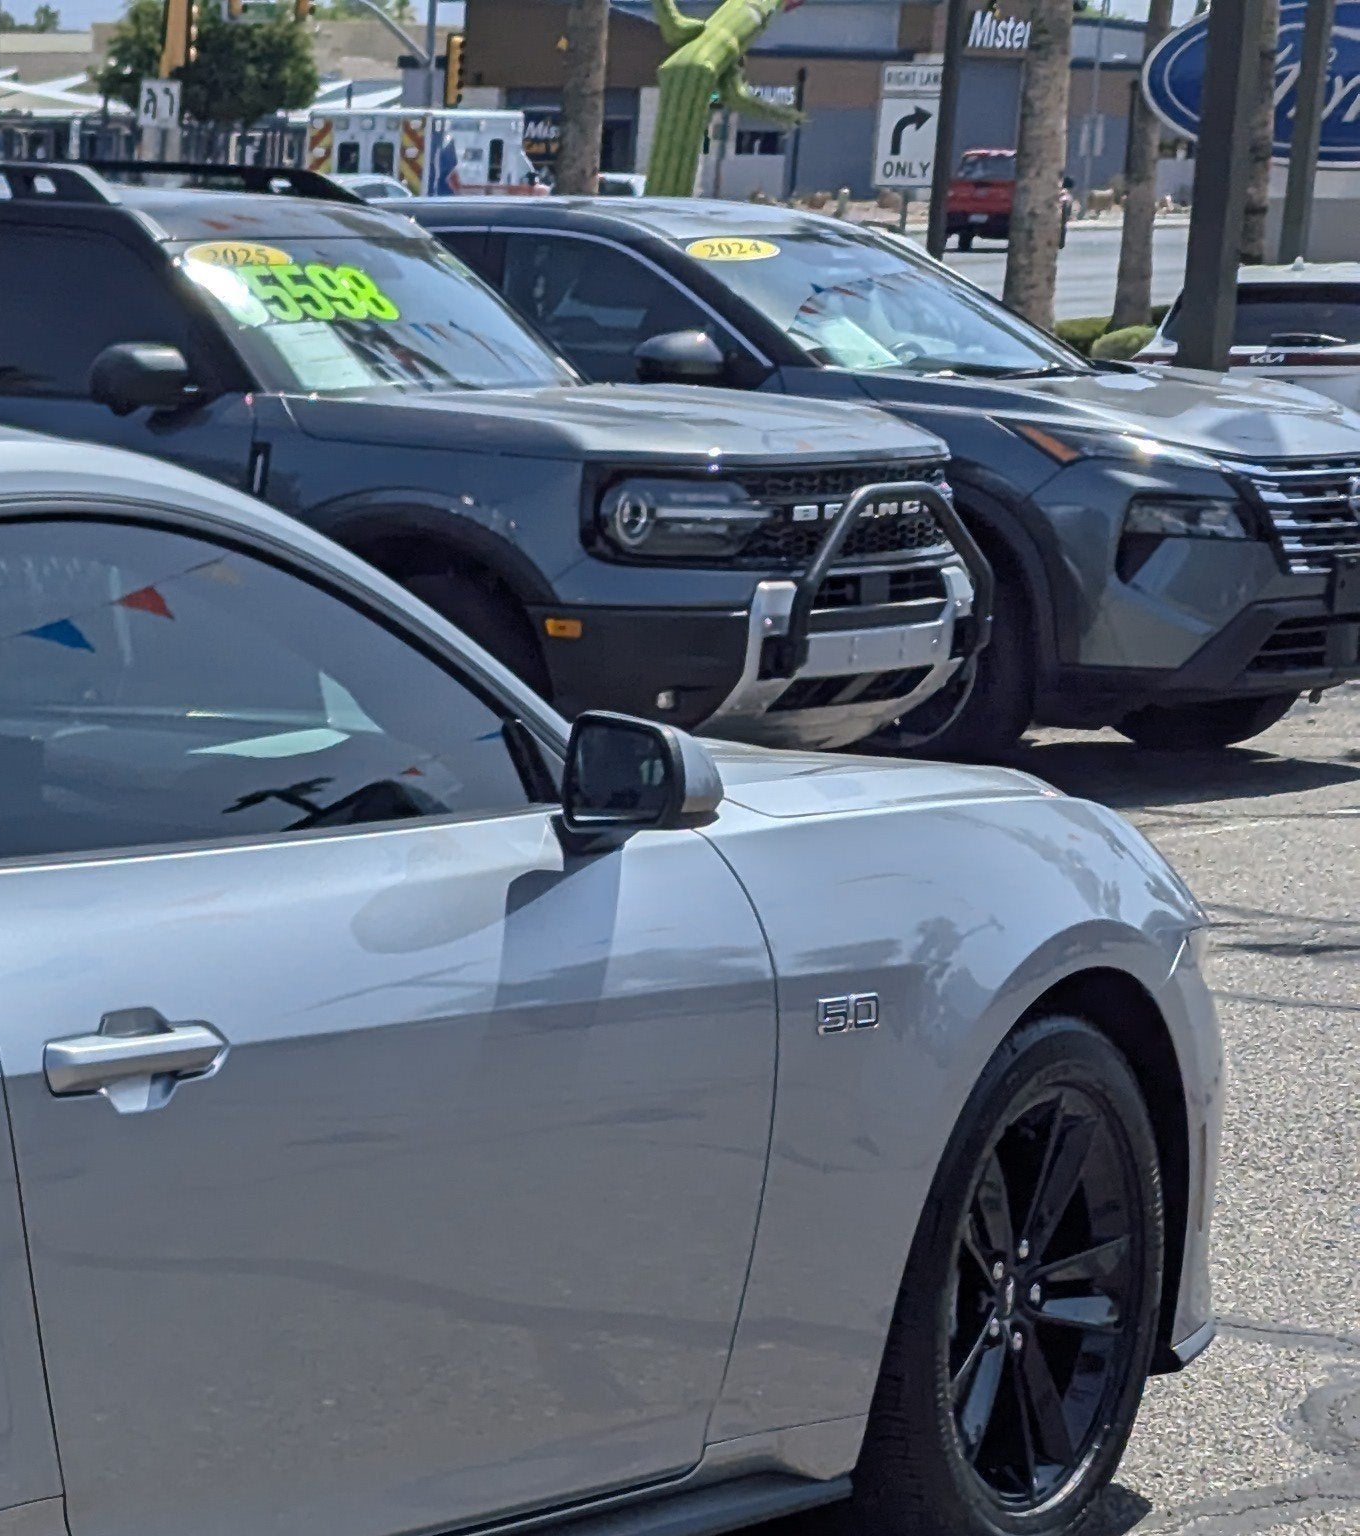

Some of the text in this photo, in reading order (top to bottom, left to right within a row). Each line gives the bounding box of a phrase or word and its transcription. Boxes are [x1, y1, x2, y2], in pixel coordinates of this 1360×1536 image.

[882, 161, 931, 178] ONLY
[204, 247, 271, 267] 2025
[703, 242, 762, 257] 2024
[817, 991, 880, 1036] 5.0
